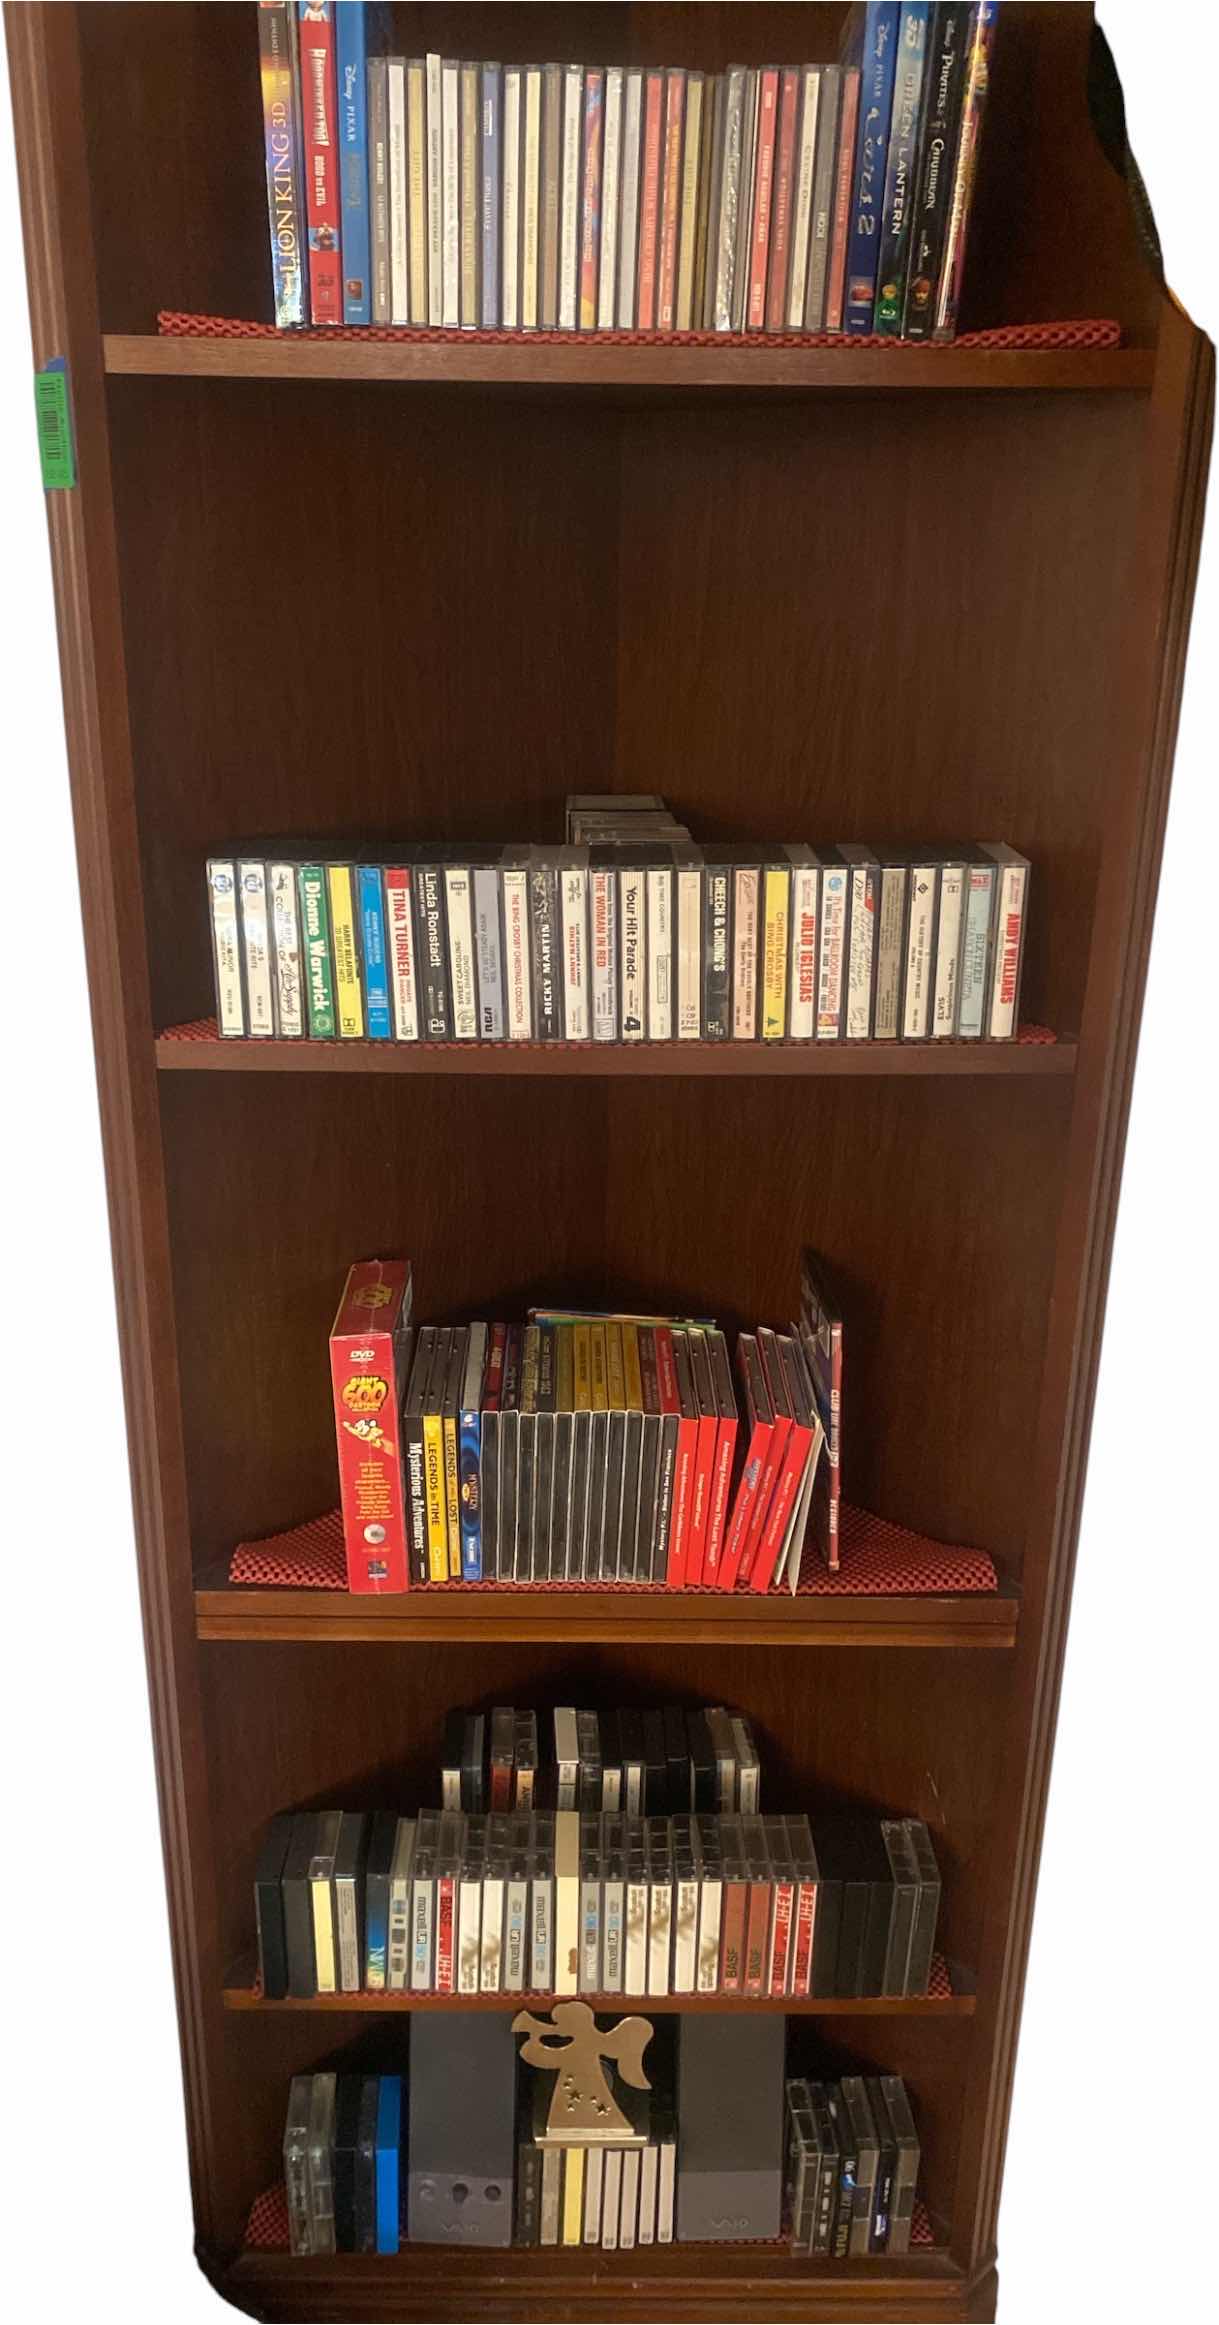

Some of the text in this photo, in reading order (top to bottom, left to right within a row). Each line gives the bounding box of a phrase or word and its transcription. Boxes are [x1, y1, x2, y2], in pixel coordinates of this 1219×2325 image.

[873, 63, 885, 97] PIXAR
[346, 105, 356, 143] PIXAR
[890, 72, 916, 236] GREEN LANTERN
[271, 102, 298, 273] LION KING 3D
[857, 213, 875, 236] 2
[343, 924, 353, 947] HARRY
[392, 890, 410, 977] TINA TURNER
[425, 872, 442, 968] Linda Ronstadt
[596, 874, 607, 968] THE WOMAN IN RED
[625, 886, 639, 980] Your Hit Parade
[713, 876, 727, 972] CHEECH & CHONG'S
[304, 880, 329, 1011] Dionne Warwick
[766, 922, 774, 990] BING CROSBY
[774, 911, 785, 999] CHRISTMAS WITH
[799, 911, 816, 1003] JULIO IGLESIAS
[999, 912, 1021, 1005] ANDY WILLIAMS
[514, 951, 522, 985] CHRISTMAS
[542, 924, 553, 1015] RICKY MARTIN
[484, 1007, 493, 1033] RCA
[515, 986, 523, 1024] COLLECTION
[624, 1016, 641, 1032] 4
[937, 997, 945, 1021] ELVIS
[350, 1350, 376, 1358] DVD
[428, 1442, 439, 1491] LEGENDS
[718, 1440, 731, 1472] Amazing
[408, 1442, 424, 1548] Mysterious Adventures
[447, 1432, 458, 1525] LEGENDS LOST
[714, 1471, 727, 1513] Adventures
[431, 1502, 441, 1526] TIME
[713, 1512, 722, 1526] The
[510, 1943, 520, 1976] maxell
[607, 1944, 618, 1977] maxell
[724, 1949, 738, 1978] BASF
